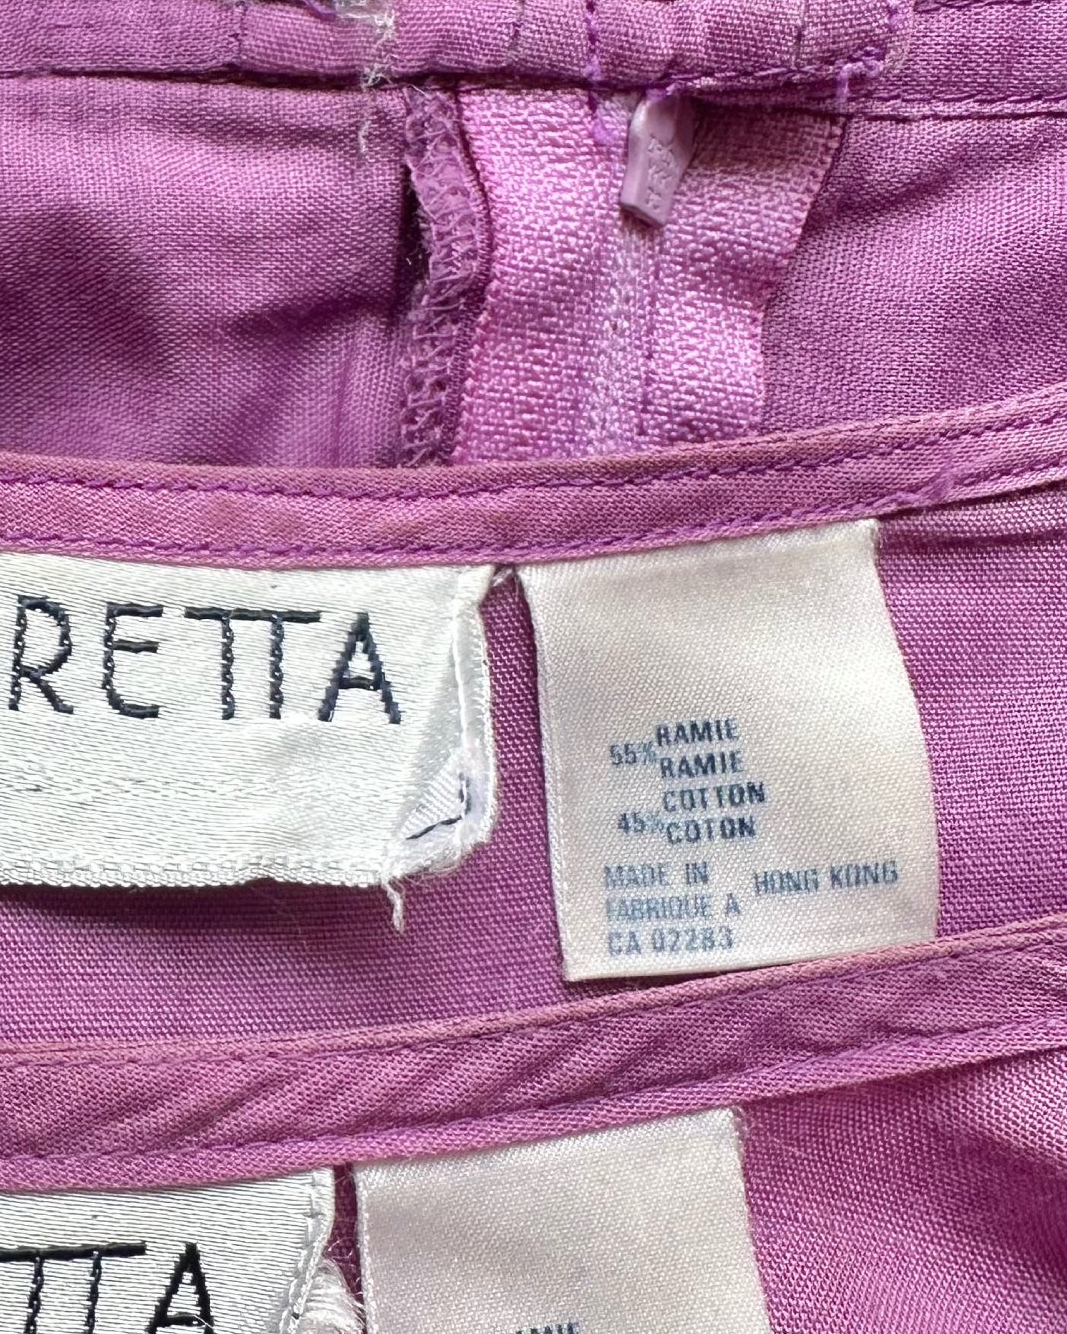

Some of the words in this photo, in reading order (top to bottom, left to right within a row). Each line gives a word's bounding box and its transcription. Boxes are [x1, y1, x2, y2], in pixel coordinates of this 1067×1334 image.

[656, 717, 740, 748] RAMIE
[660, 750, 743, 779] RAMIE
[662, 781, 766, 812] COTTON
[666, 815, 756, 844] COTON
[603, 865, 670, 888] MADE
[685, 862, 708, 885] IN
[753, 869, 820, 896] HONG
[830, 859, 898, 888] KONG
[605, 895, 712, 921] FABRIQUE
[725, 892, 741, 916] A
[607, 931, 643, 957] CA
